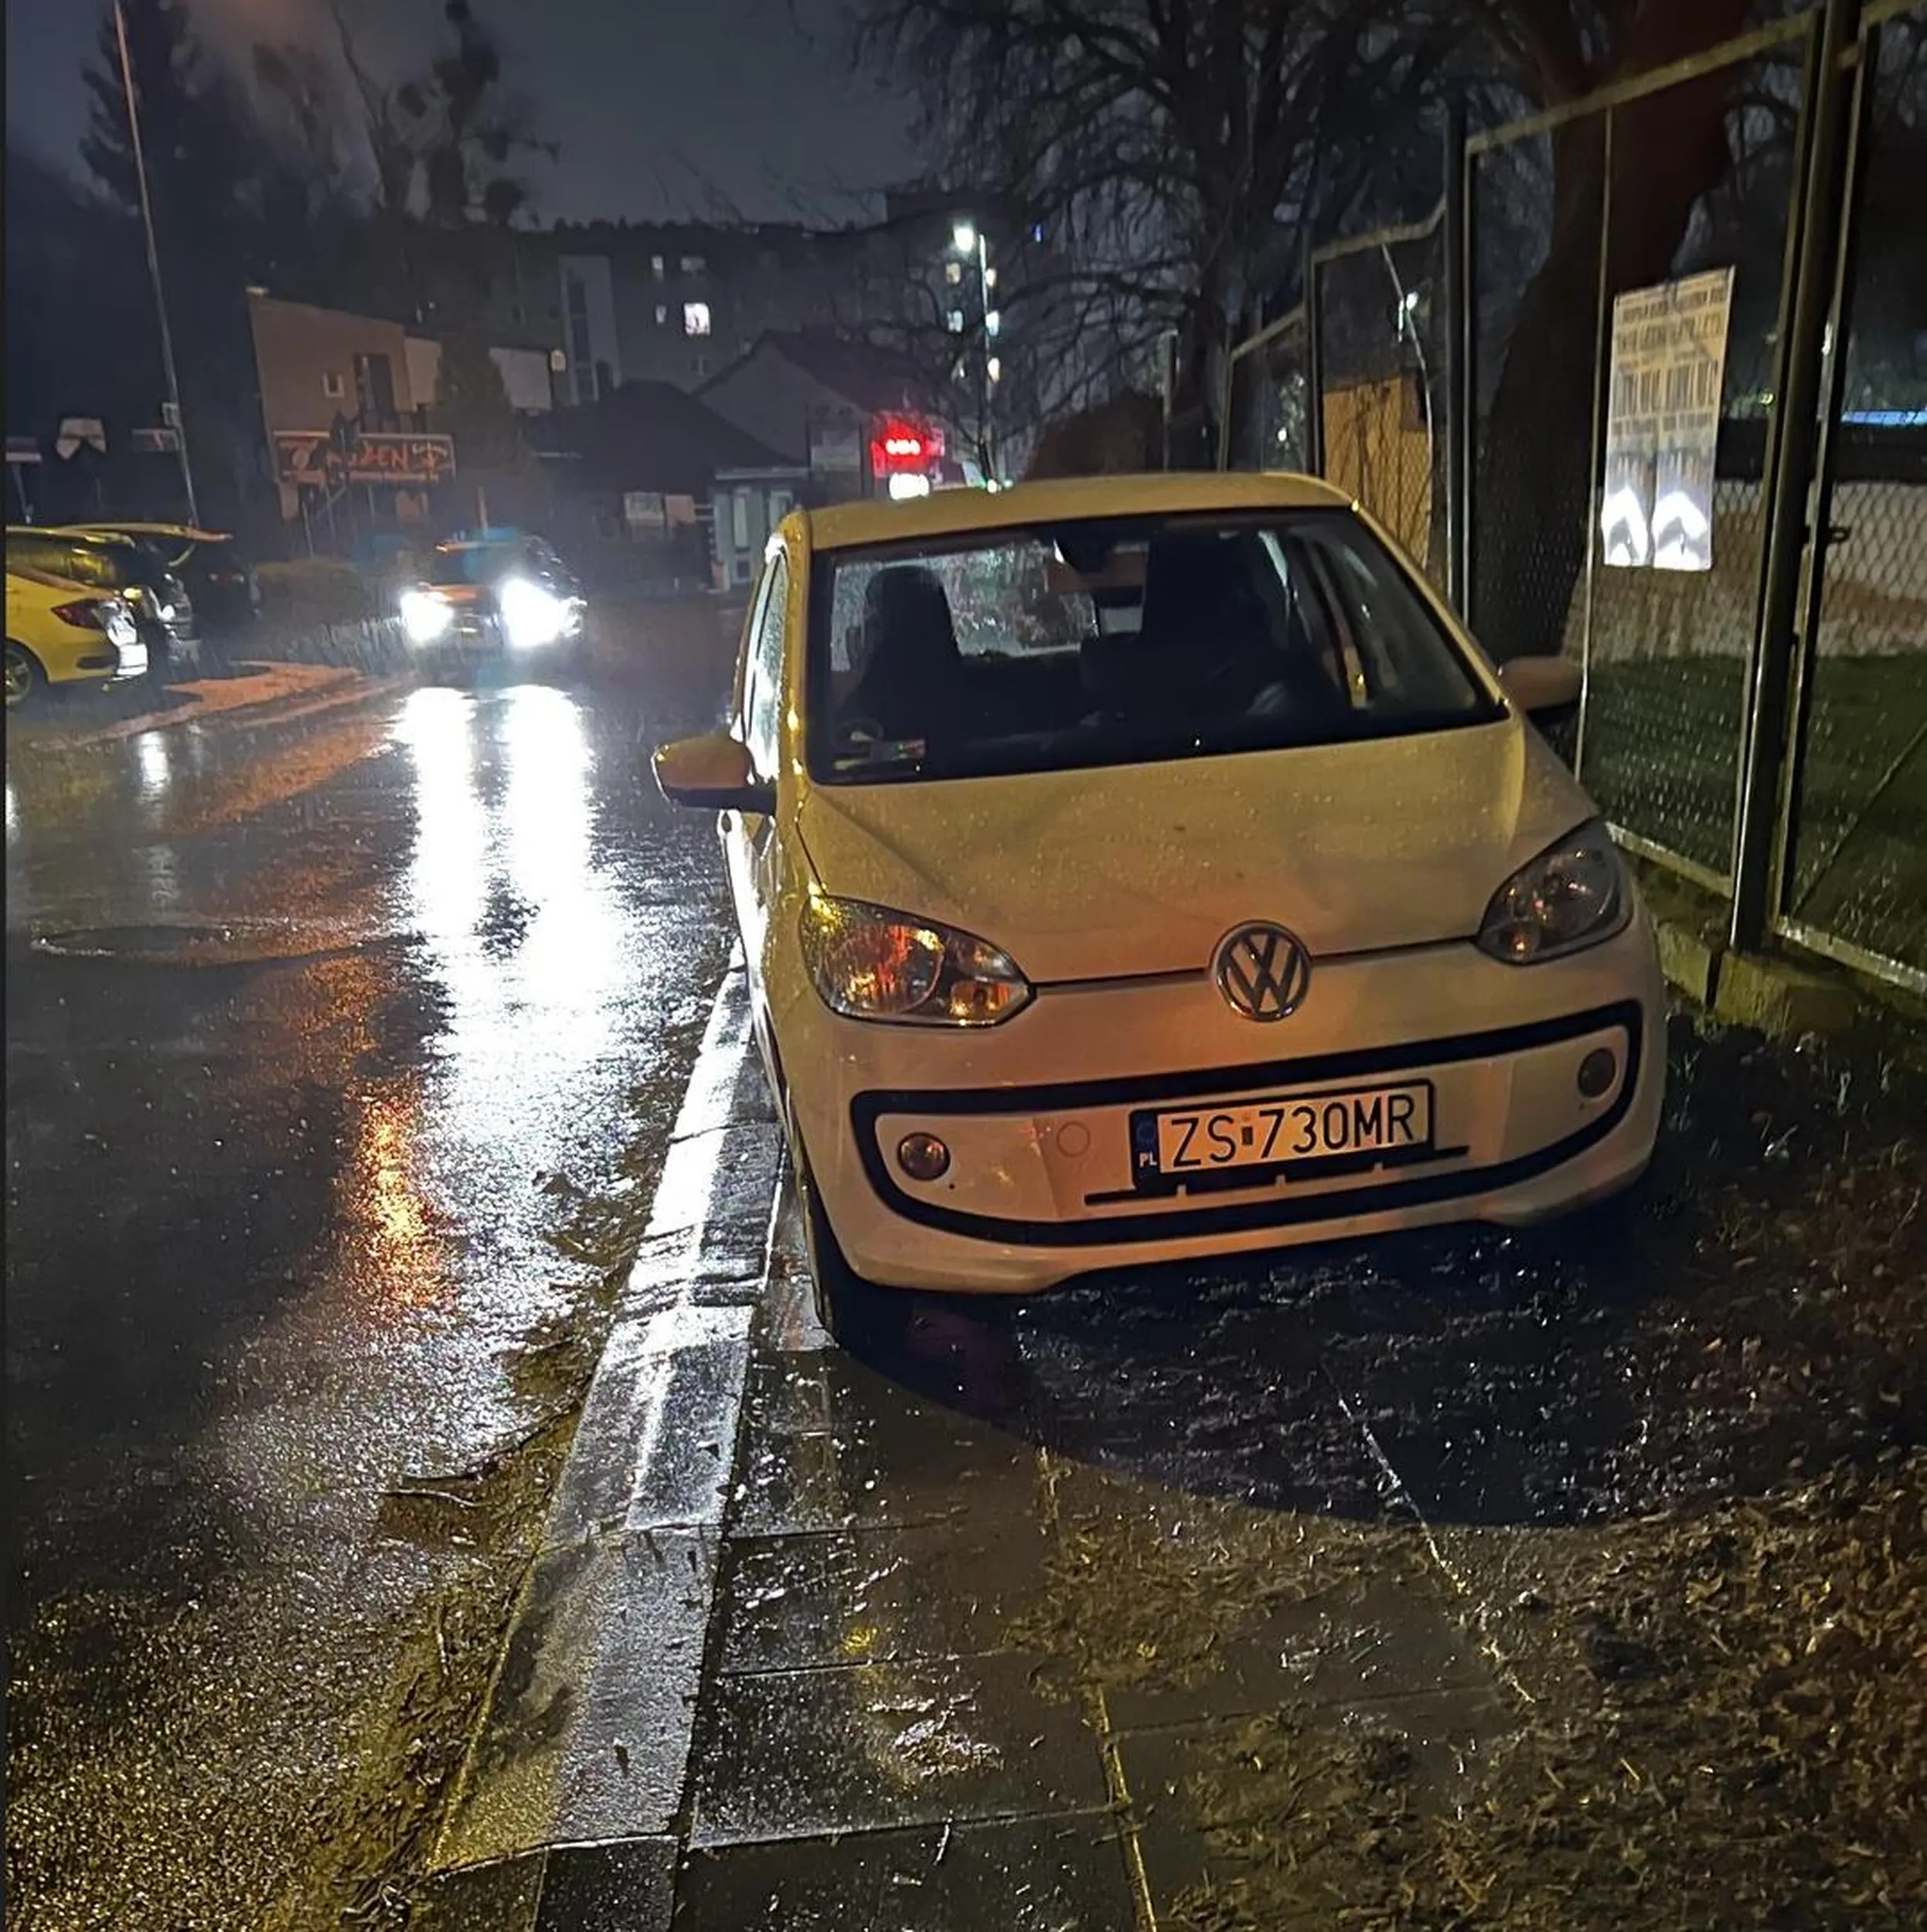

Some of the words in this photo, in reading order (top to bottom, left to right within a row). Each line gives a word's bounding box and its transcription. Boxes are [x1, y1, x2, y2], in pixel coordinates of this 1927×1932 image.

[1219, 924, 1305, 1018] VW
[1139, 1151, 1158, 1168] PL
[1171, 1116, 1235, 1168] ZS
[1259, 1094, 1415, 1159] 730MR
